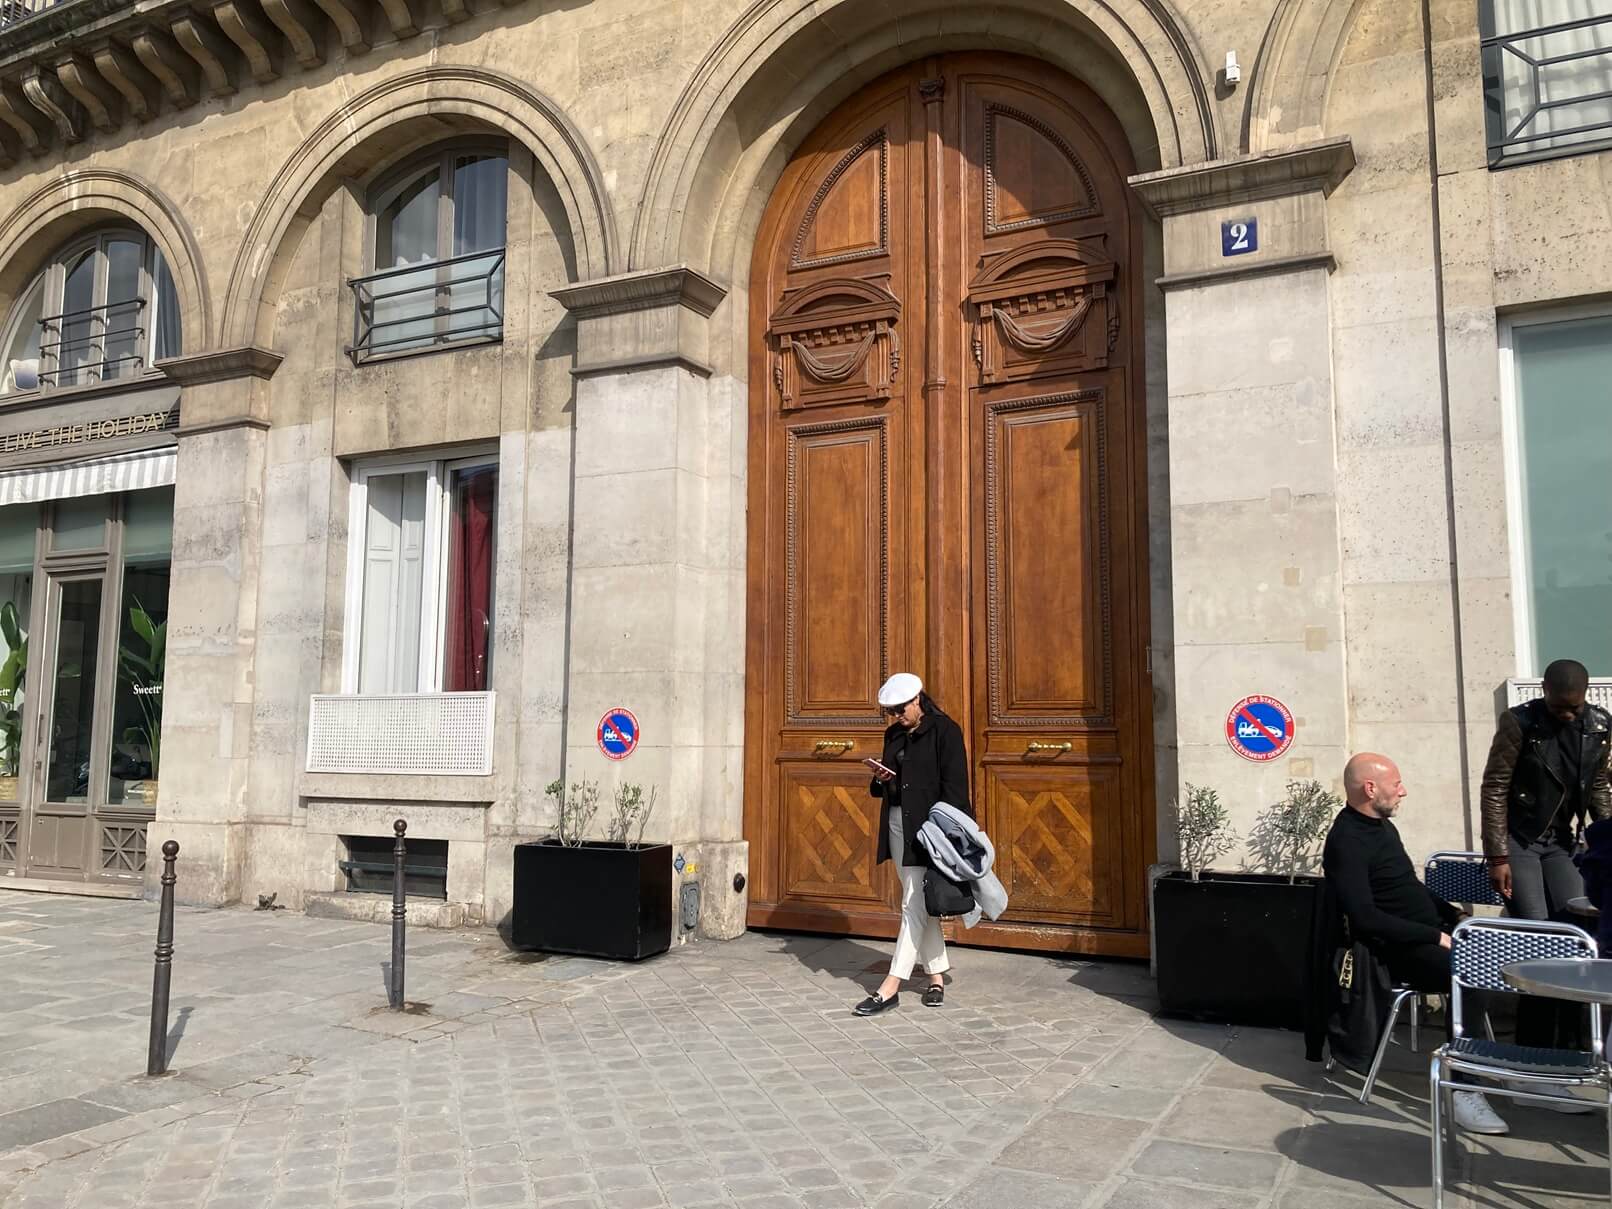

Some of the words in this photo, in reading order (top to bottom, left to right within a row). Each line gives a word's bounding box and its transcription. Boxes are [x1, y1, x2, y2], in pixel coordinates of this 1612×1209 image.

[1230, 223, 1249, 250] 2
[4, 431, 43, 452] LIVE
[49, 424, 83, 446] THE
[87, 412, 169, 440] HOLIDAY
[1260, 697, 1293, 723] STATIONNER
